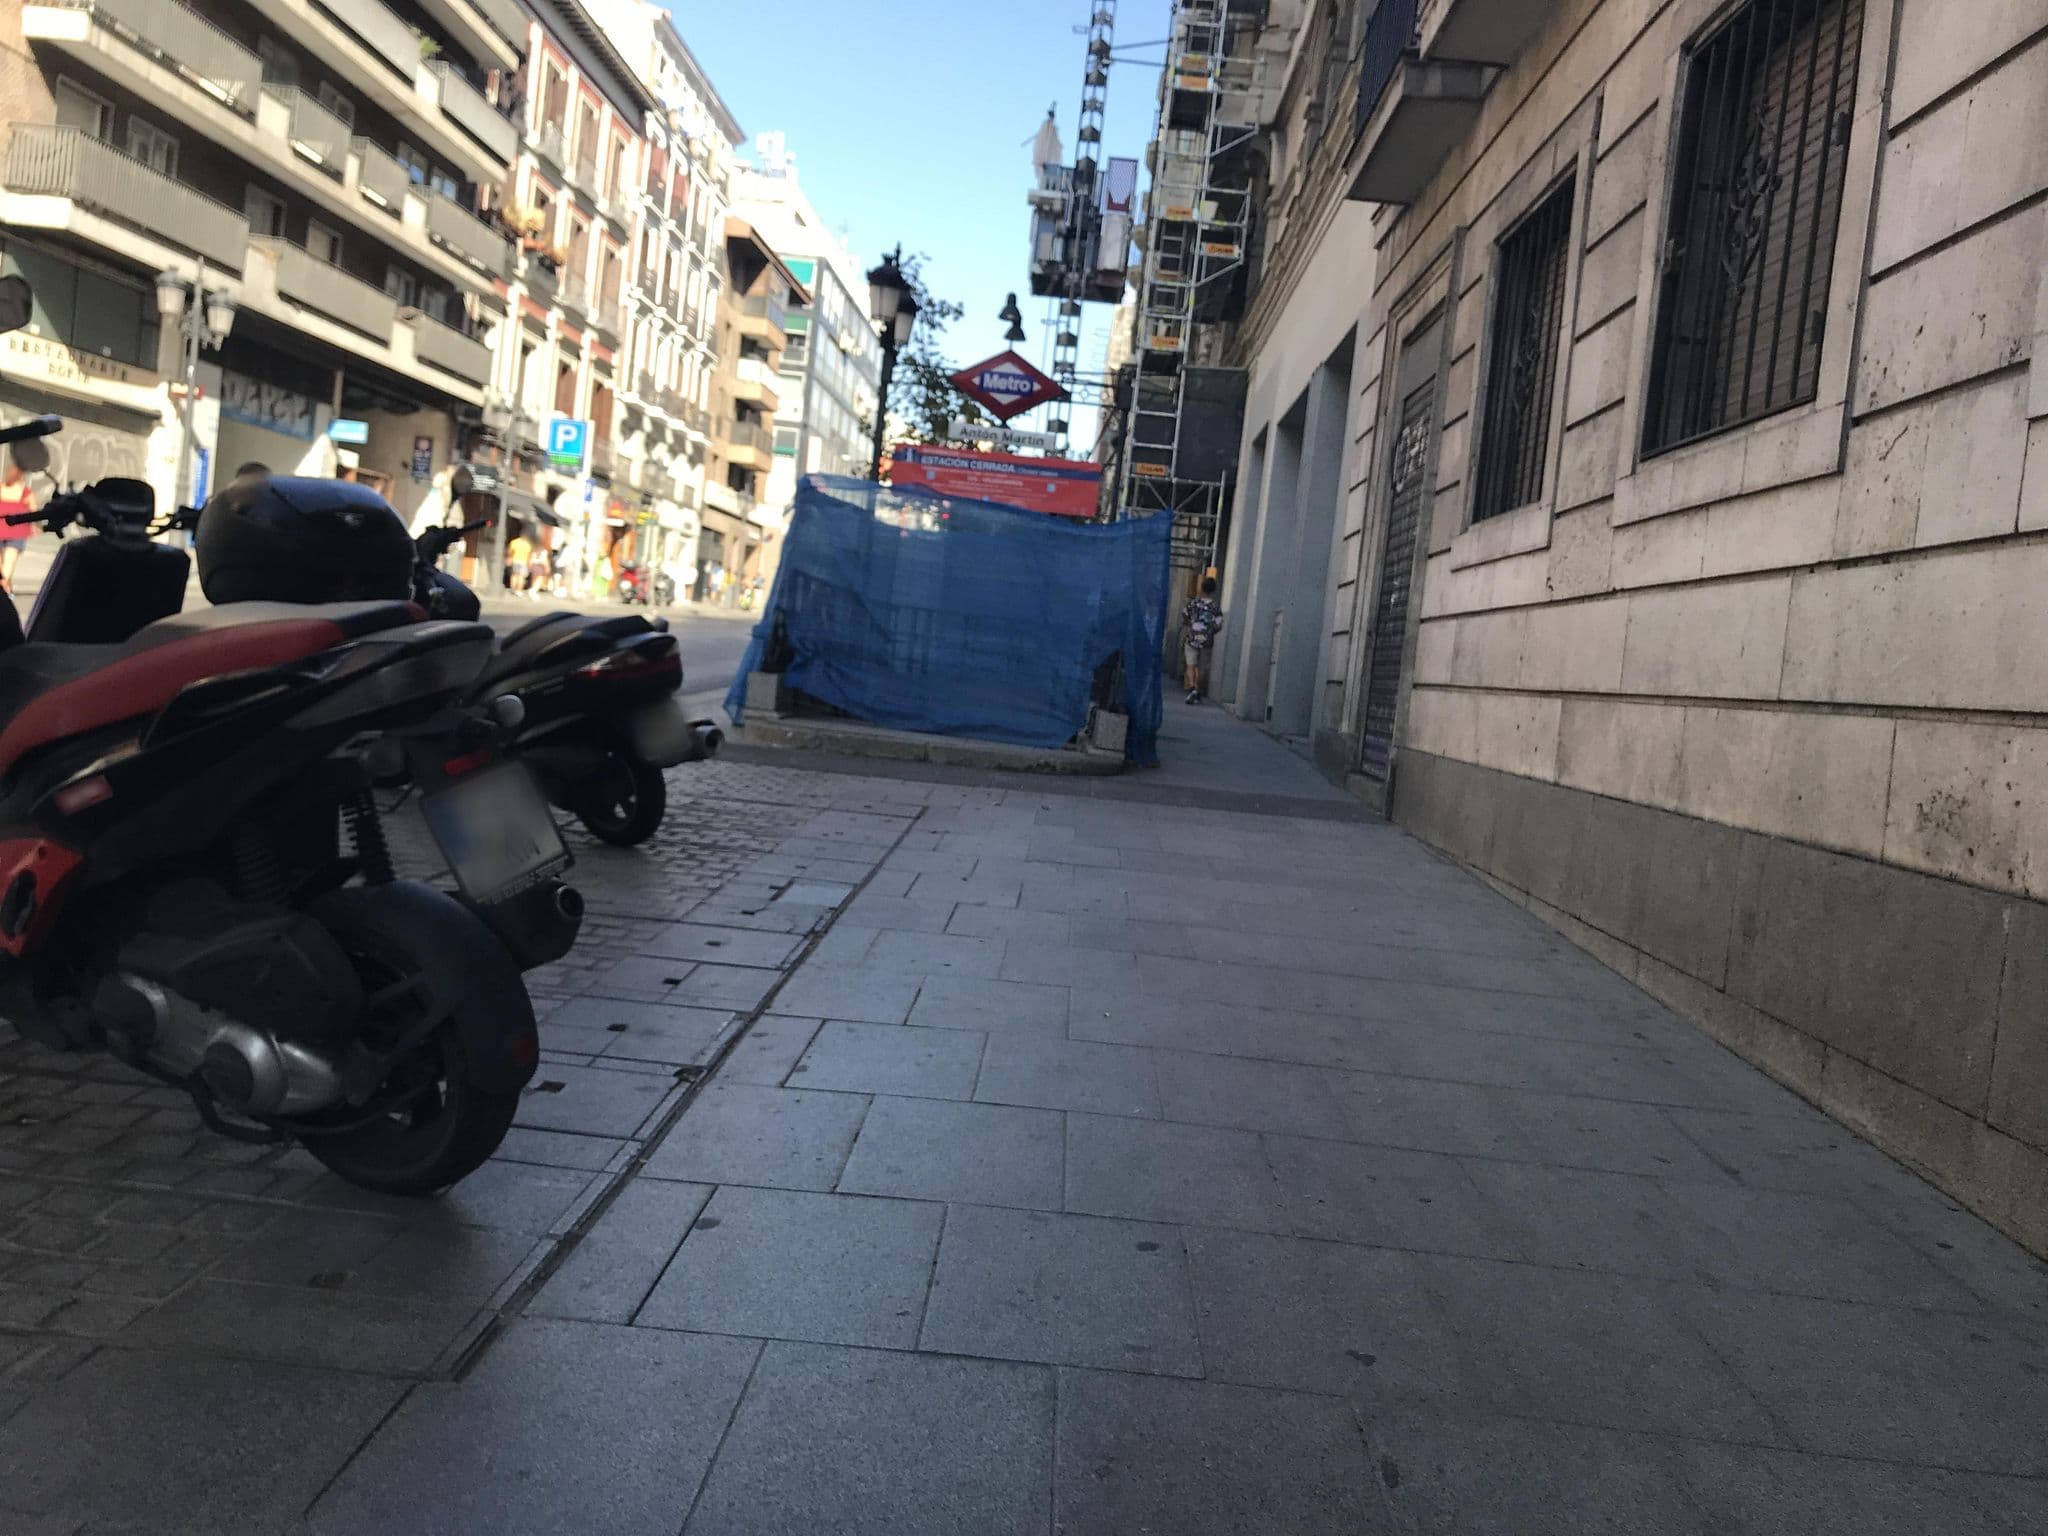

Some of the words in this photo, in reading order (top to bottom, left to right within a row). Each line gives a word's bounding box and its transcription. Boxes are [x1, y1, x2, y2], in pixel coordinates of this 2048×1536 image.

[983, 373, 1031, 392] Metro
[556, 425, 578, 451] P
[970, 460, 1016, 473] CERRADA
